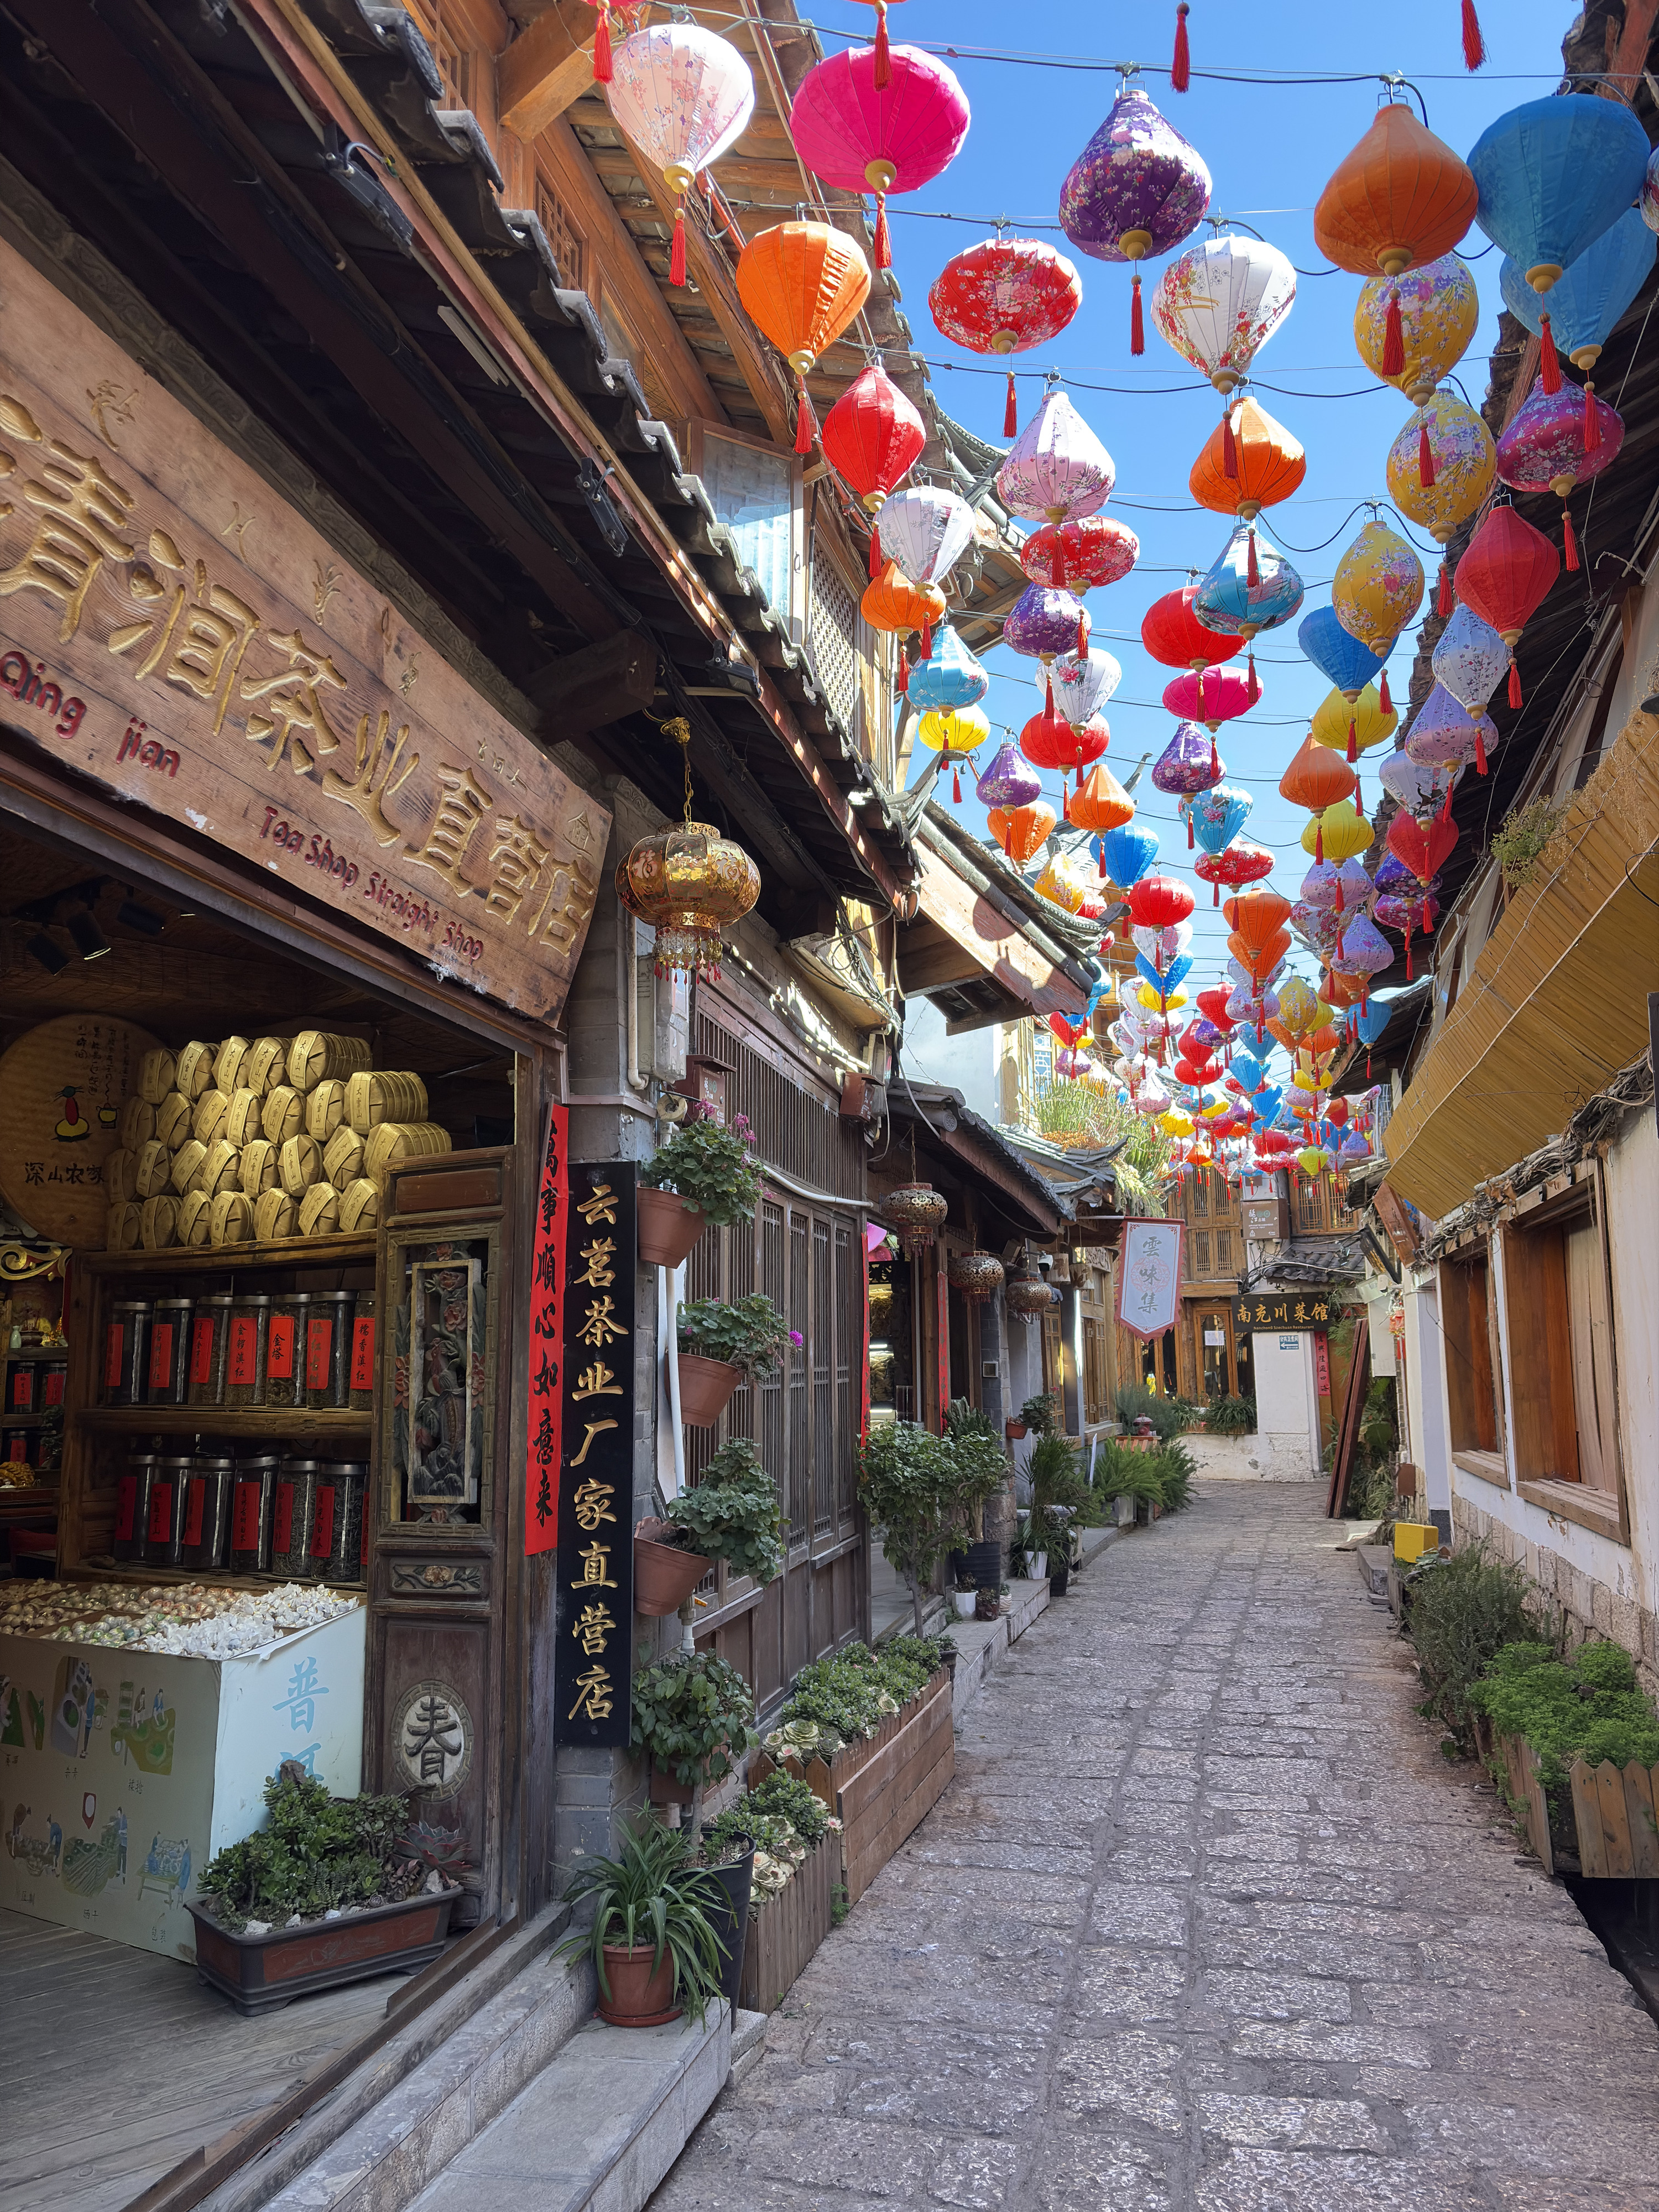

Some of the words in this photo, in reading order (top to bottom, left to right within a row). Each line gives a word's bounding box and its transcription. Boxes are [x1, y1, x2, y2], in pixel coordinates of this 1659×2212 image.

[0, 651, 86, 739] Qing
[117, 717, 180, 779] jian
[259, 806, 304, 855] Tea
[305, 834, 358, 891] Shop
[364, 872, 438, 935] Straight
[442, 921, 483, 965] Shop
[24, 1162, 106, 1186] 深山农家
[1138, 1236, 1162, 1314] 雲味集
[1237, 1301, 1329, 1323] 南充川菜馆
[272, 1333, 285, 1360] 金塔
[568, 1185, 629, 1720] 云茗茶业厂家直营店
[404, 1697, 462, 1783] 春
